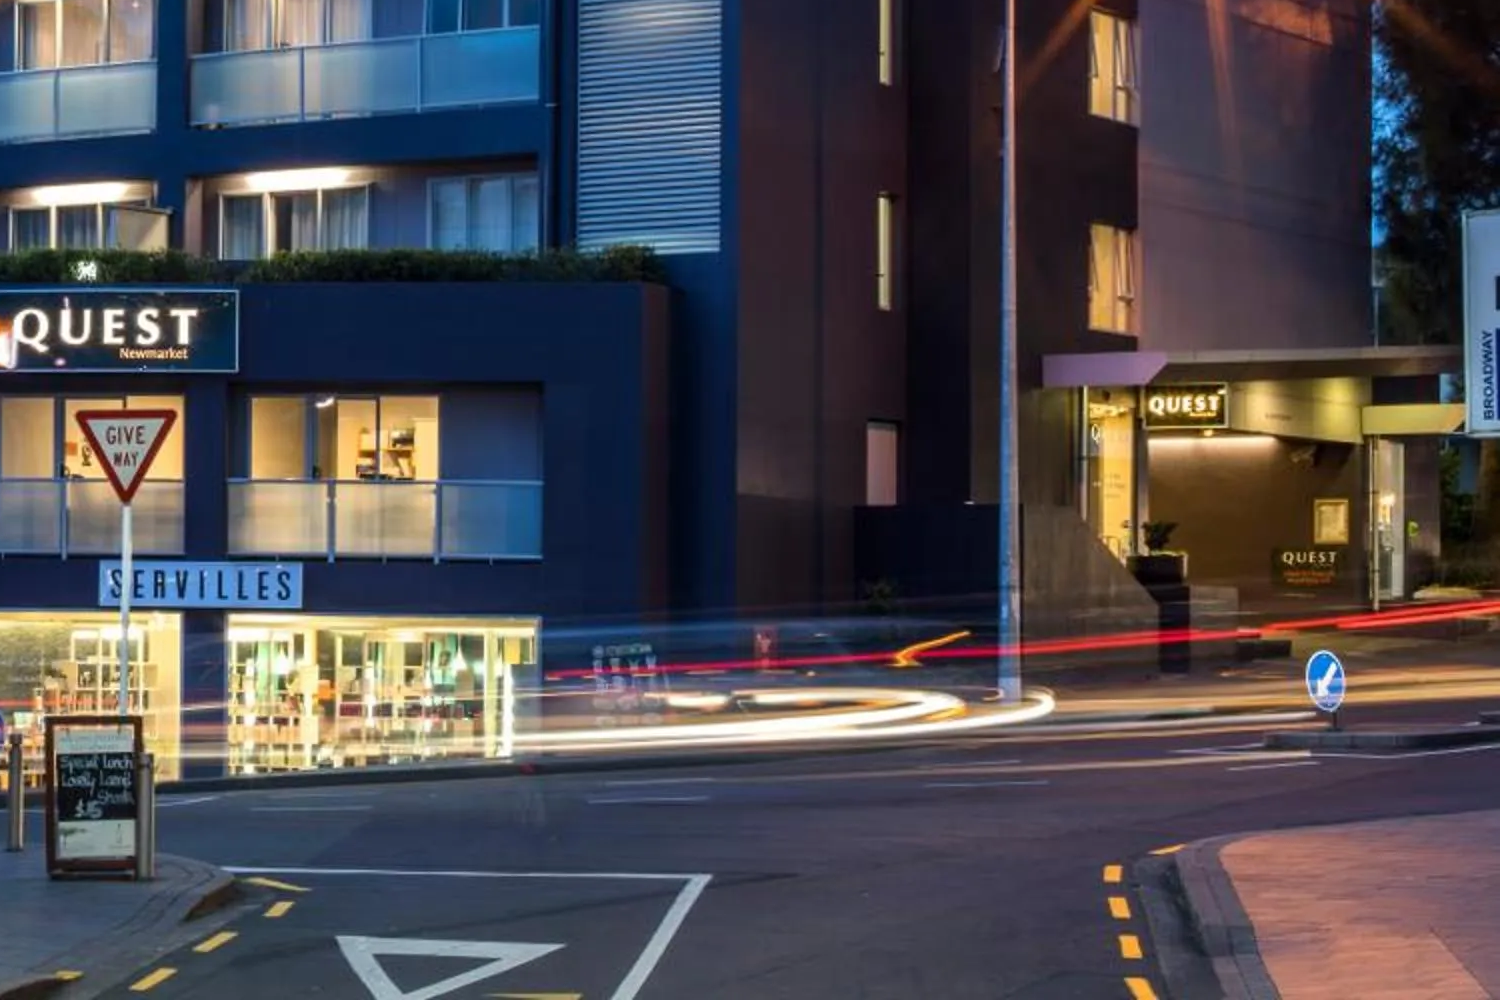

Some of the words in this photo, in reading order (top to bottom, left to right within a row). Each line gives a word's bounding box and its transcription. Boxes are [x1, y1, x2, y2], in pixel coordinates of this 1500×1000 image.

[13, 307, 199, 352] QUEST
[119, 347, 188, 360] Newmarket
[1482, 330, 1494, 421] BROADWAY
[1148, 394, 1220, 417] QUEST
[105, 425, 146, 445] GIVE
[113, 451, 140, 468] WAY
[1282, 551, 1337, 566] QUEST
[110, 568, 292, 601] SERVILLES
